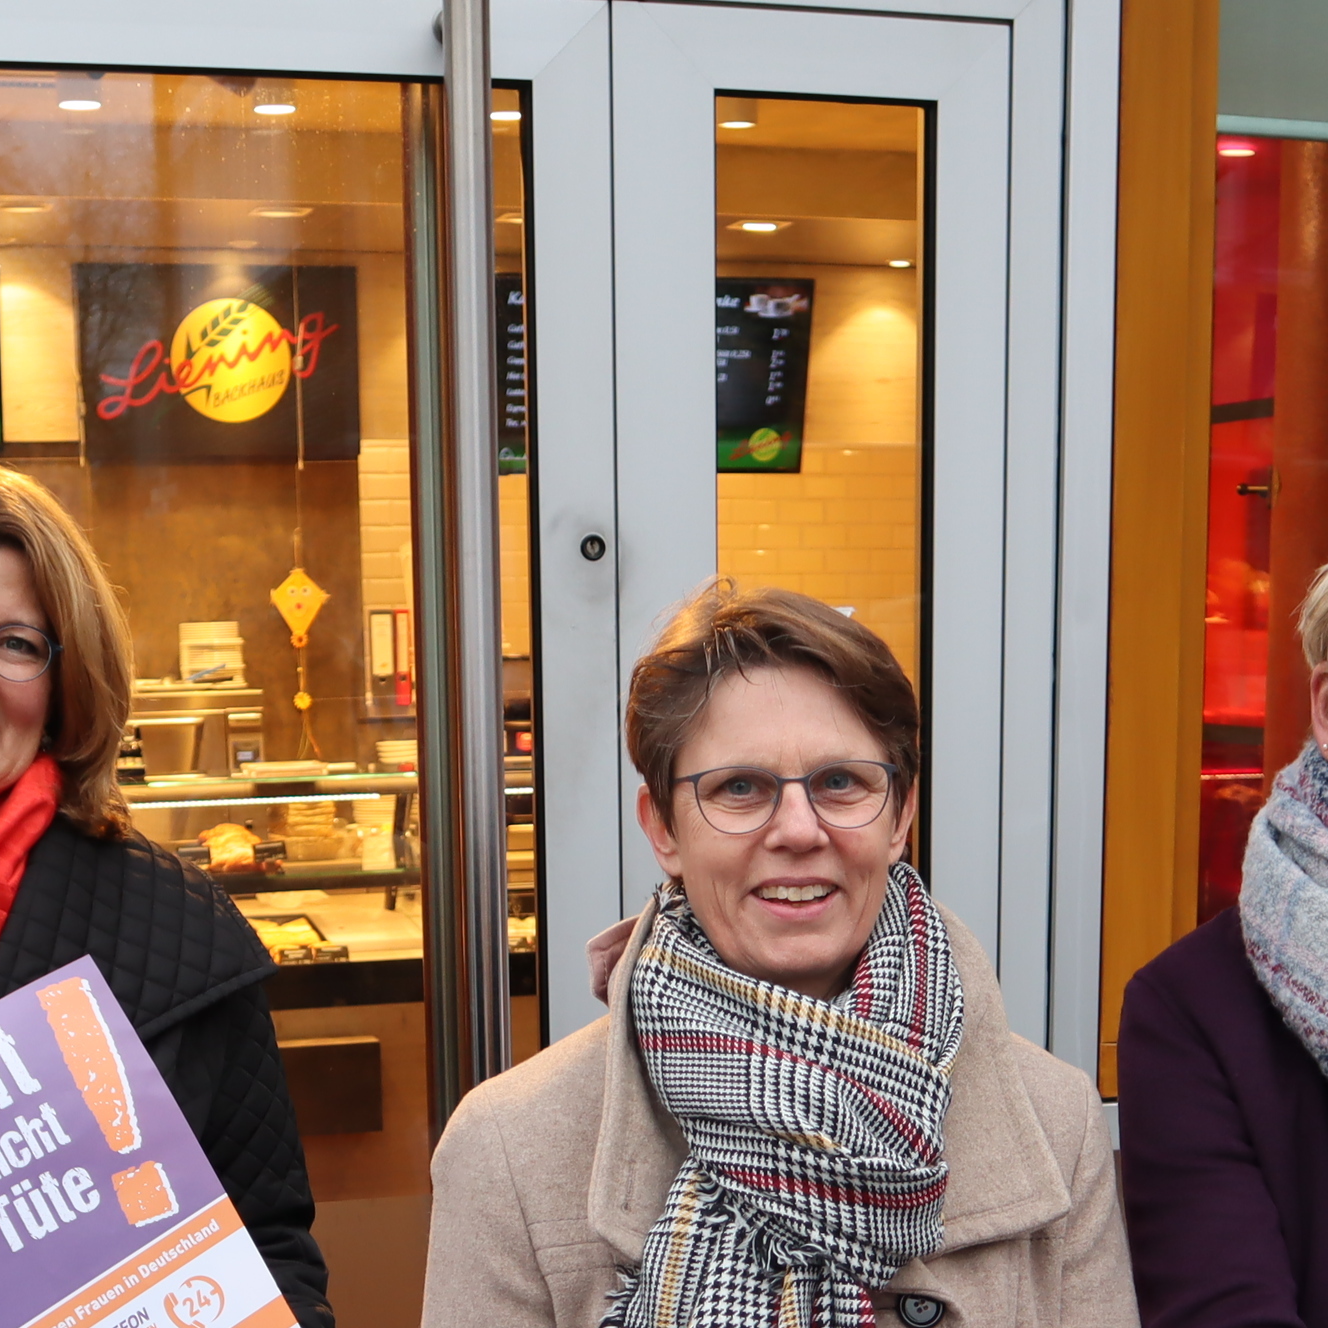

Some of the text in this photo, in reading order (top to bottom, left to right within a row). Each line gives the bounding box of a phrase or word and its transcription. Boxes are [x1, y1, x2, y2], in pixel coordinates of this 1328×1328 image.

[74, 1283, 125, 1320] Frauen
[121, 1271, 140, 1290] in
[137, 1218, 219, 1278] Deutschland
[181, 1289, 211, 1317] 24
